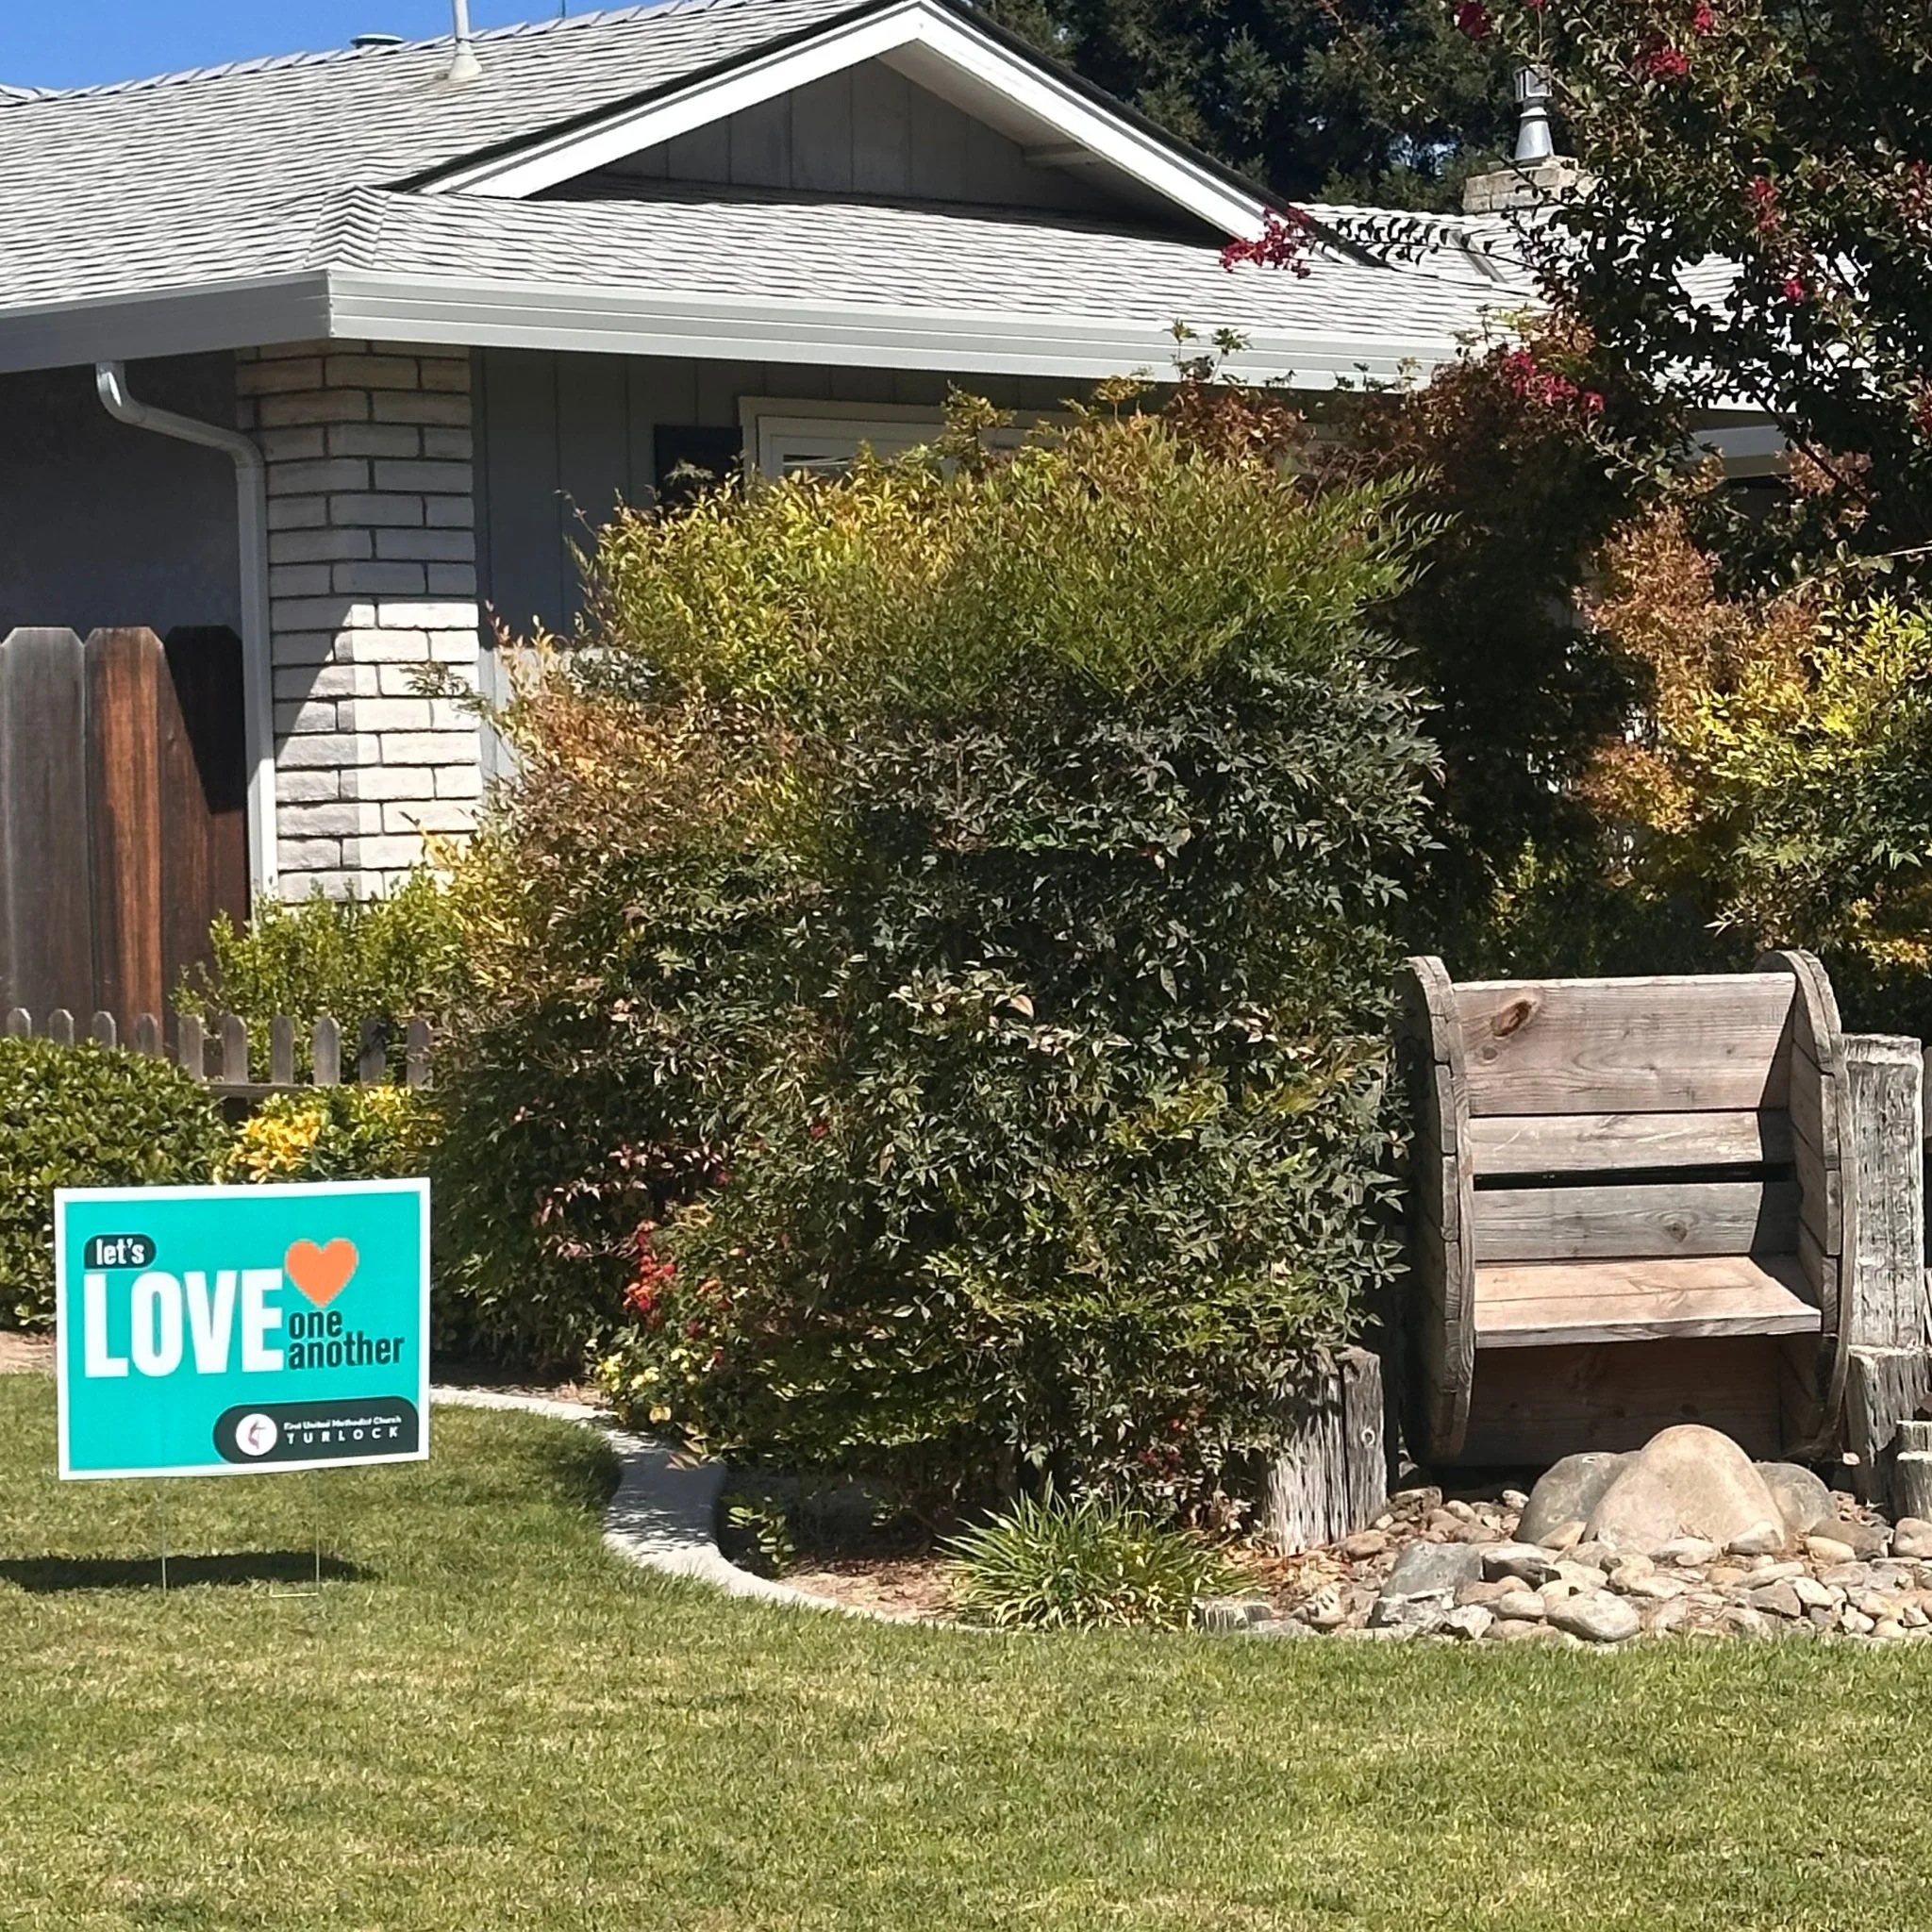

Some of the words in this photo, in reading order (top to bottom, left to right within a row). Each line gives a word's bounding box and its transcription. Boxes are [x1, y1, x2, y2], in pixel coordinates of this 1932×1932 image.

[96, 1238, 145, 1266] let's
[83, 1268, 285, 1378] LOVE
[288, 1309, 343, 1341] one
[288, 1330, 406, 1371] another
[373, 1415, 403, 1425] Church
[287, 1426, 398, 1445] TURLOCK
